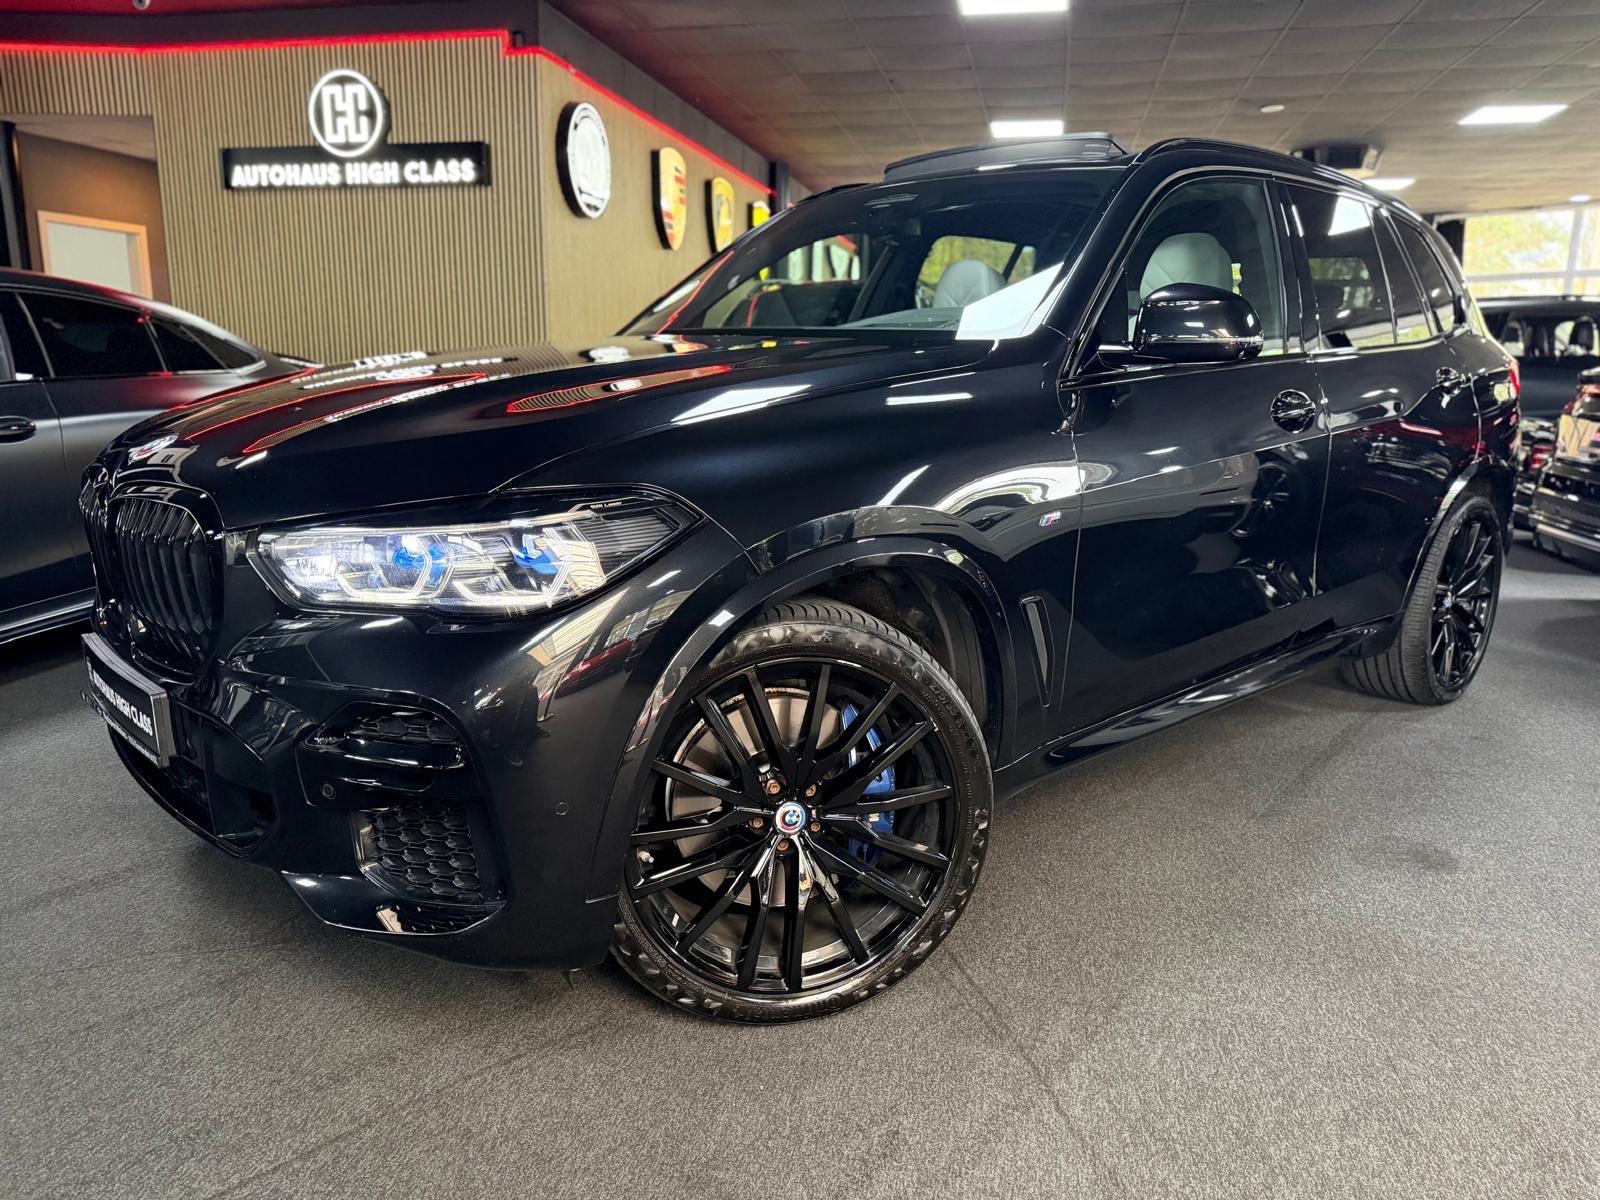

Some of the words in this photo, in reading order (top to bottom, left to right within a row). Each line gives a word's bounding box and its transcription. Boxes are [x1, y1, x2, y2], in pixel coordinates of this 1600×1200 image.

[231, 164, 342, 187] AUTOHAUS
[345, 161, 399, 185] HIGH
[404, 158, 476, 183] CLASS
[115, 692, 132, 719] HIGH
[130, 705, 153, 736] CLASS
